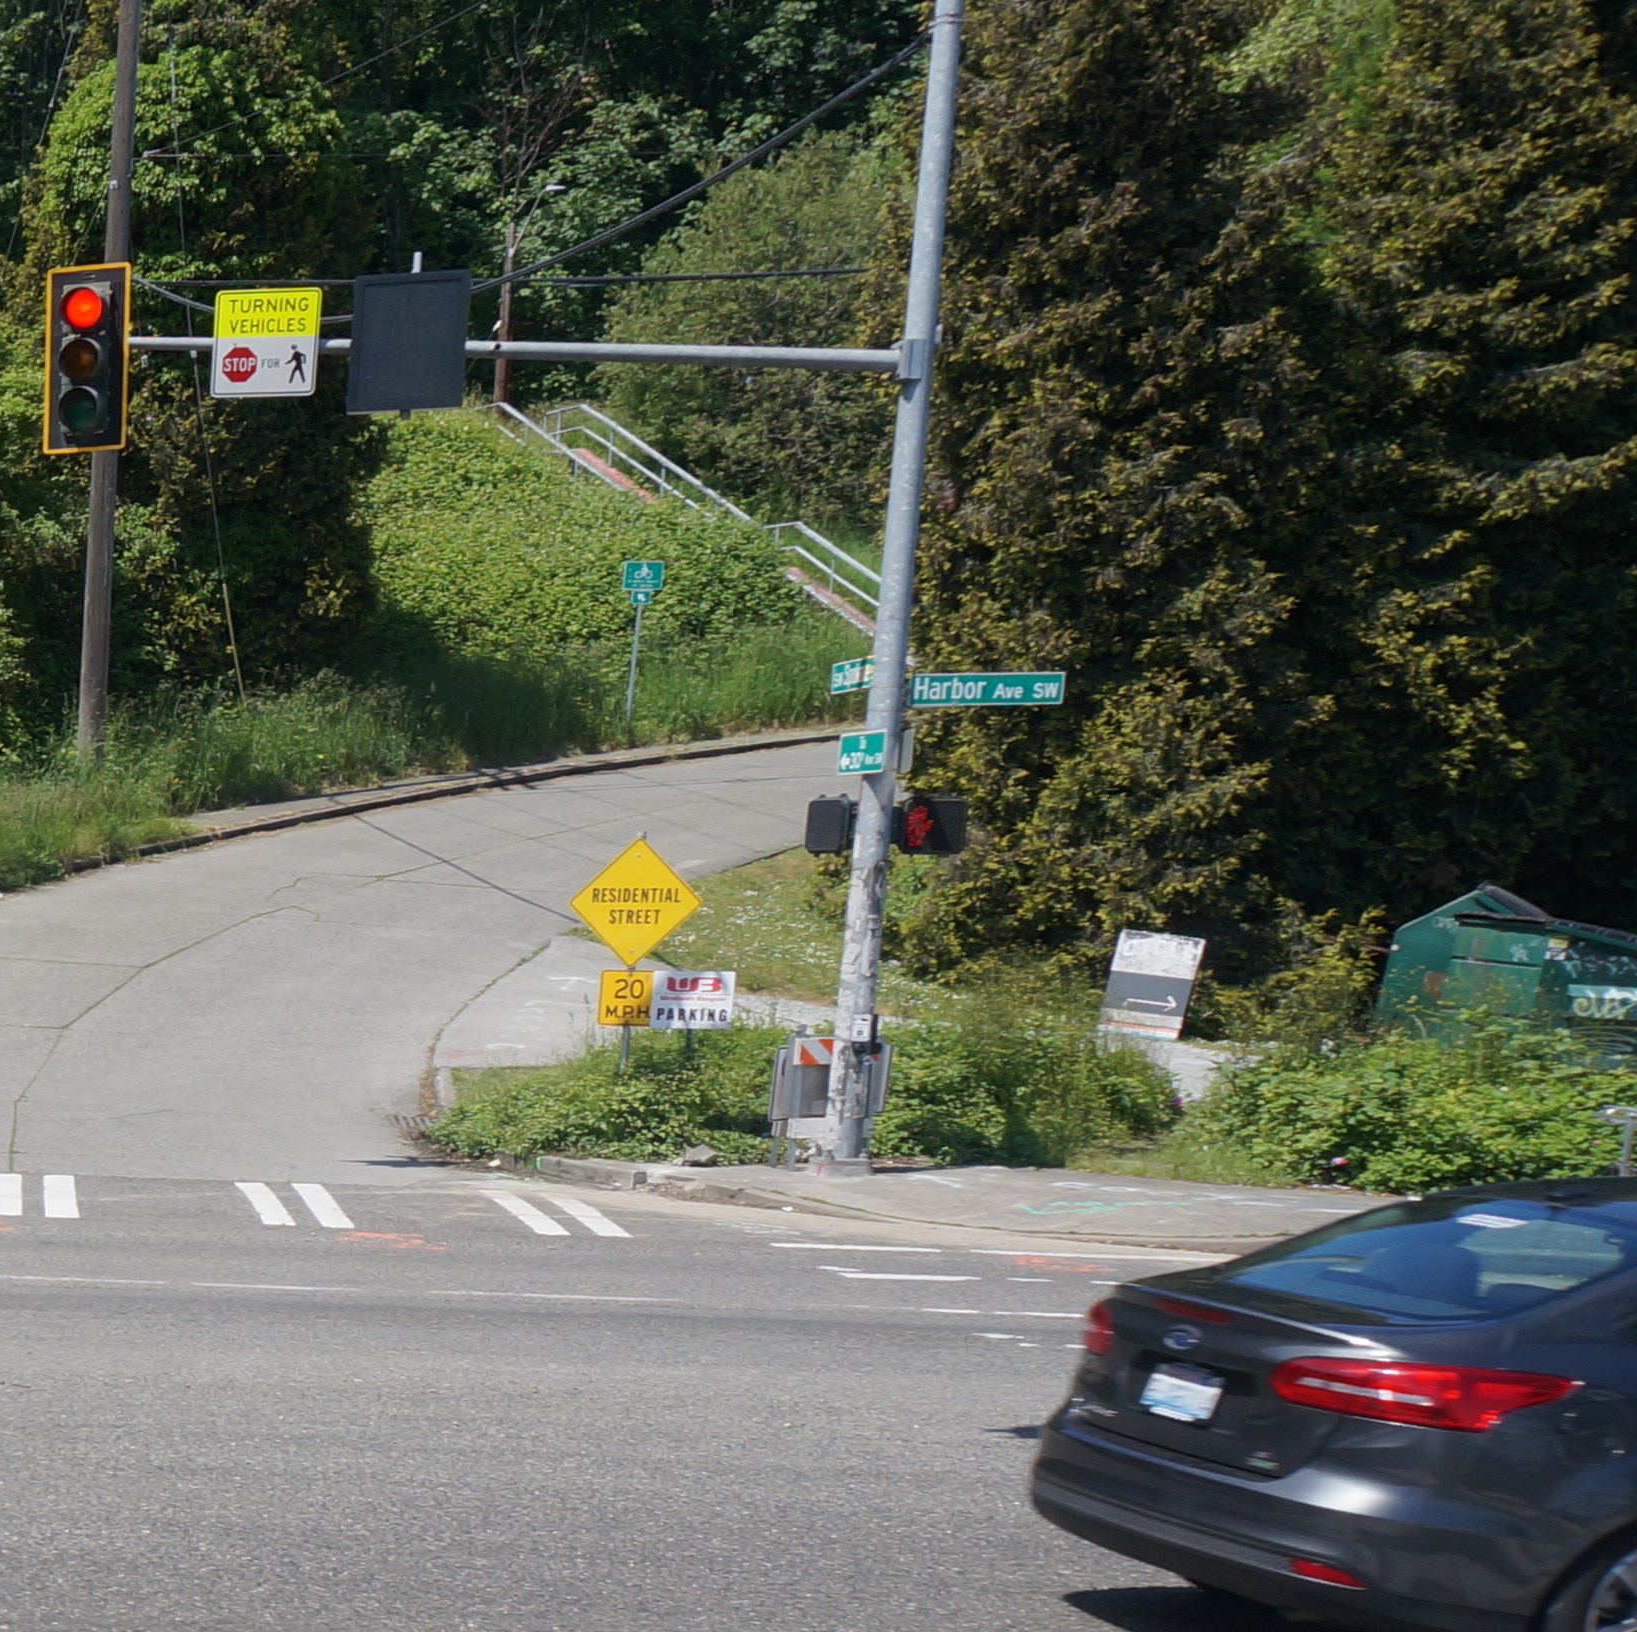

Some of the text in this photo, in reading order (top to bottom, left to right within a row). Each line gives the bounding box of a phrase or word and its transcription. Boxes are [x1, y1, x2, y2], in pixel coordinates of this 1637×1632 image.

[229, 297, 309, 314] TURNING
[229, 317, 307, 333] VEHICLES
[223, 358, 280, 372] STOP FOR
[913, 677, 1060, 700] Harbor Ave SW
[591, 887, 682, 903] RESIDENTIAL
[609, 909, 662, 925] STREET
[613, 978, 645, 999] 20
[656, 1007, 728, 1022] PARKING
